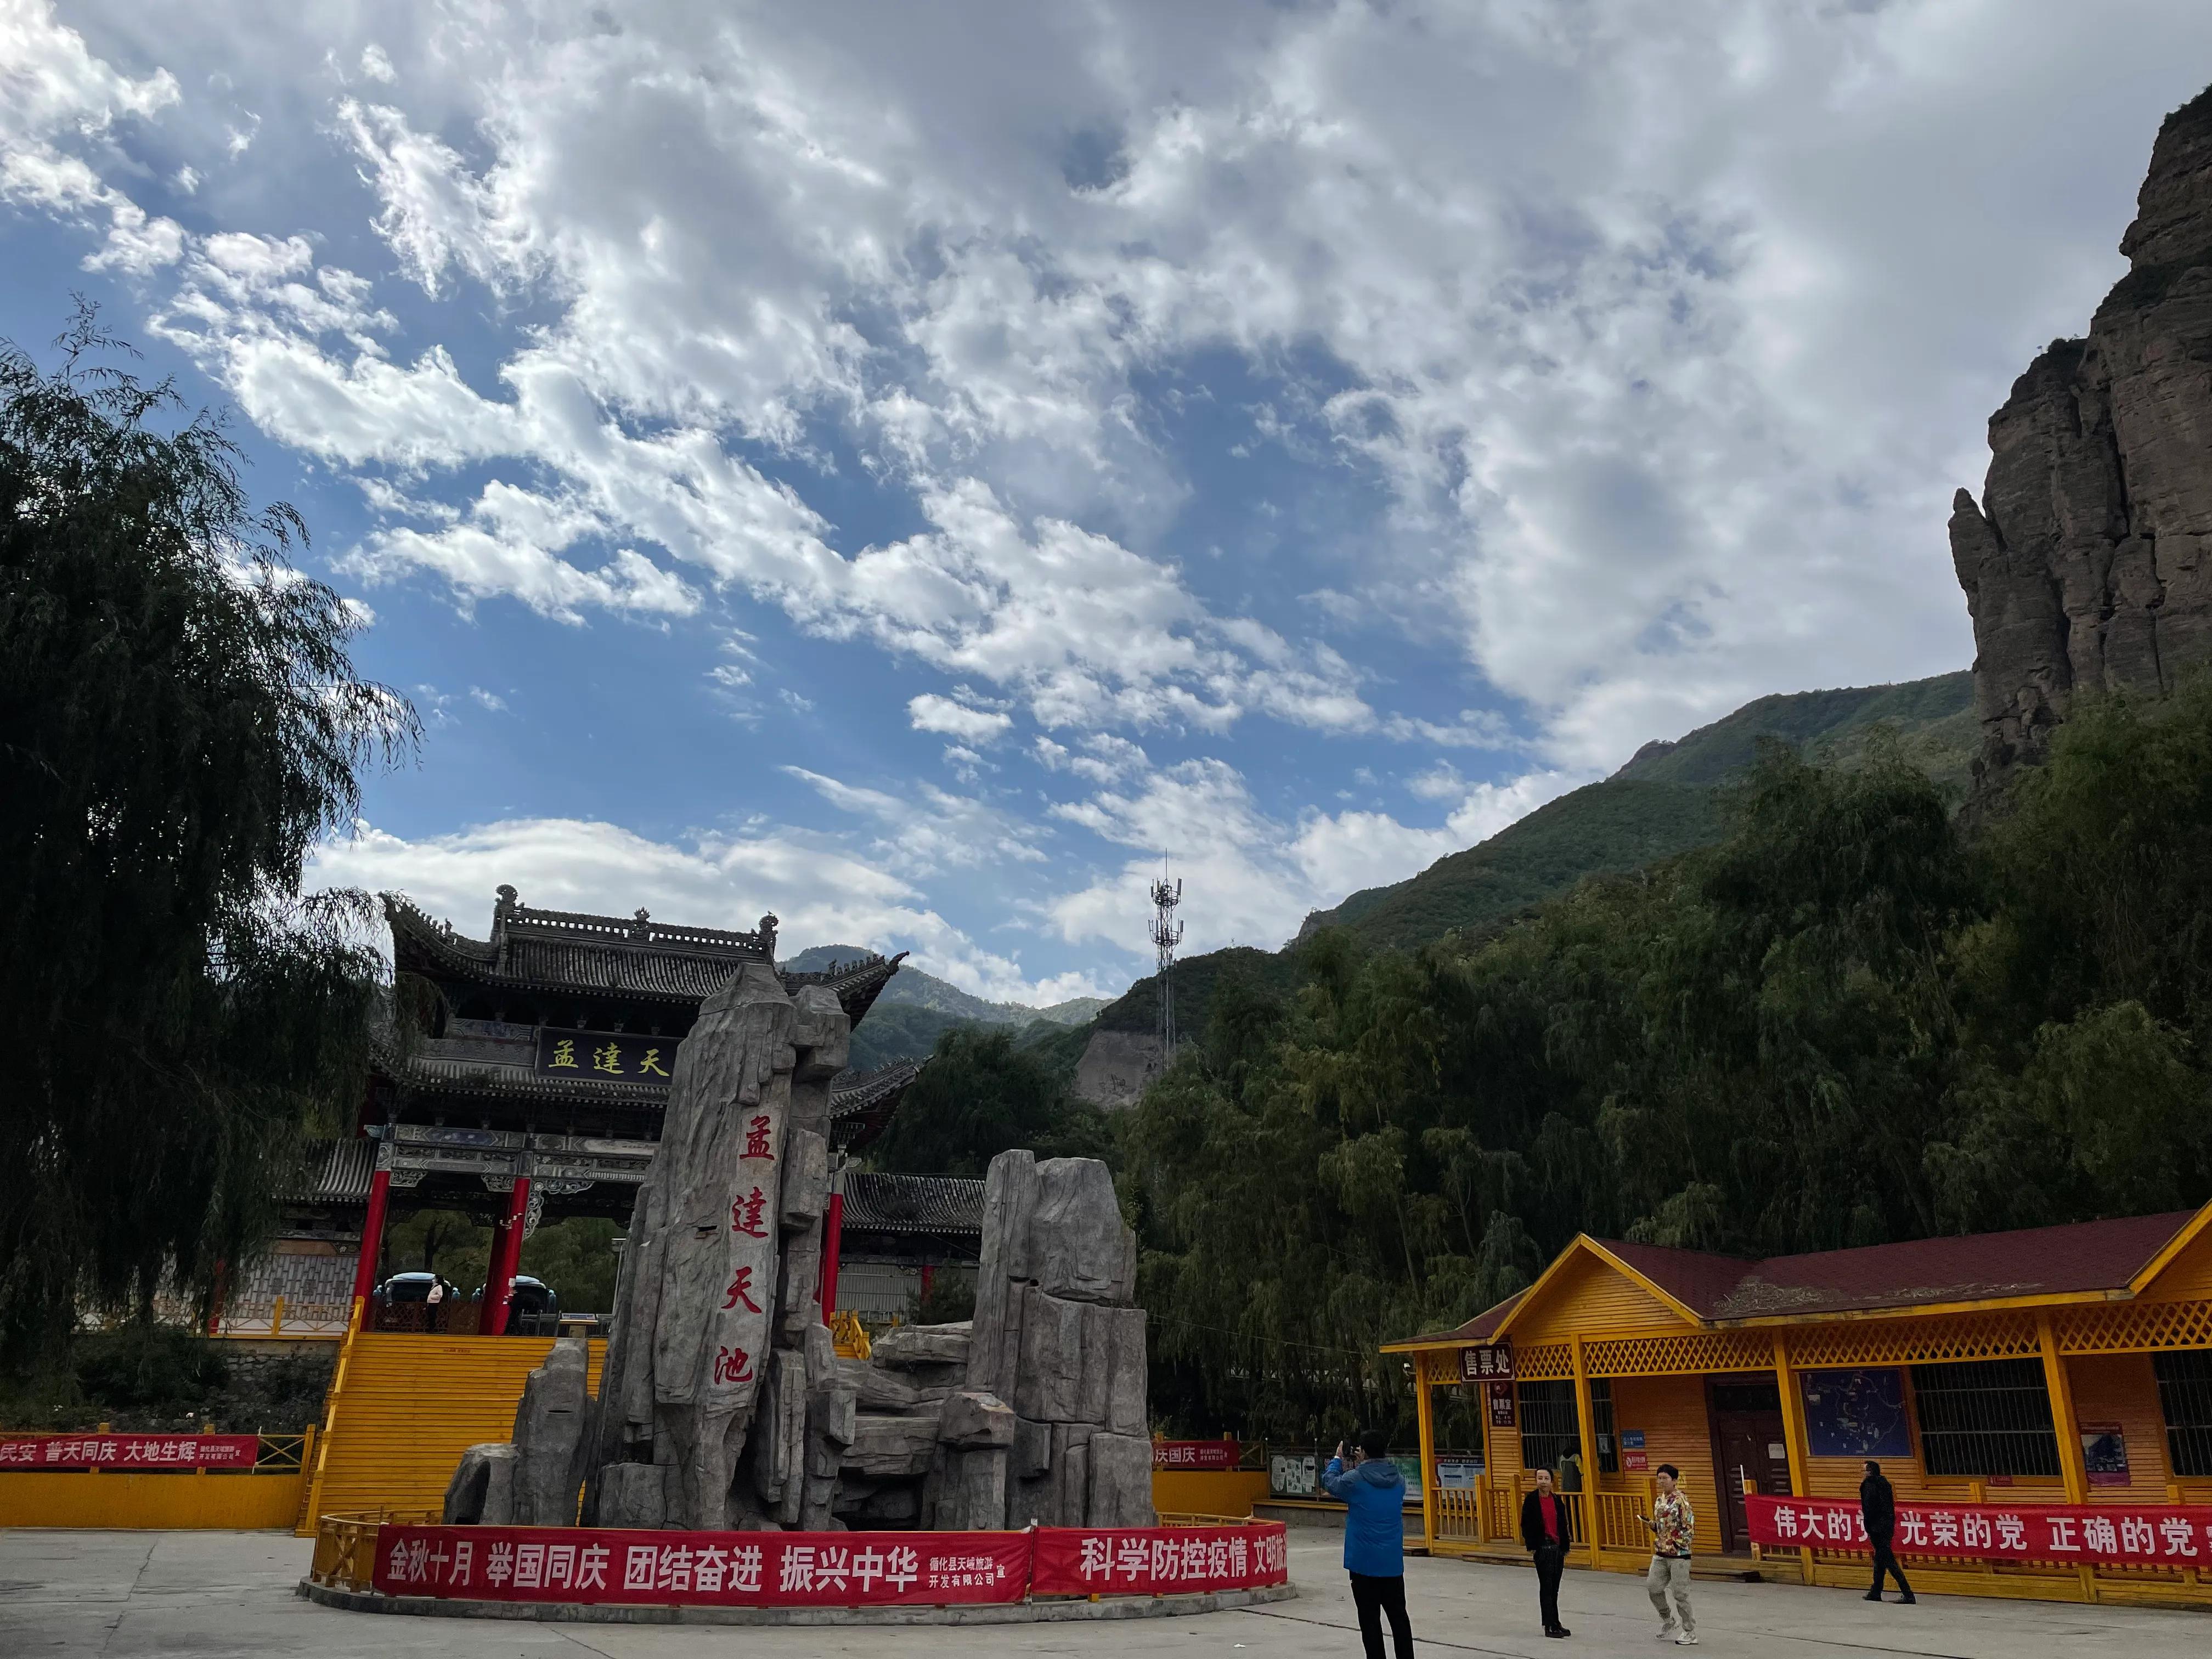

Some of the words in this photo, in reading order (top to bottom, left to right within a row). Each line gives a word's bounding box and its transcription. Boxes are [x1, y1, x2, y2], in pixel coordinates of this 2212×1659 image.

[714, 1115, 775, 1385] 孟達天池
[1465, 1349, 1510, 1376] 售票处
[0, 1443, 37, 1462] 民安
[46, 1441, 117, 1462] 普天同庆
[124, 1441, 197, 1462] 大地生辉
[1152, 1446, 1195, 1463] 庆国庆
[1900, 1511, 2028, 1550] 光荣的党
[2046, 1516, 2198, 1556] 正确的党
[387, 1538, 473, 1586] 金秋十月
[486, 1542, 610, 1590] 举国同庆
[624, 1544, 762, 1593] 团结奋进
[780, 1545, 917, 1593] 振兴中华
[930, 1556, 993, 1571] 循化县天域旅游
[1081, 1537, 1247, 1583] 科学防控疫情
[1254, 1533, 1286, 1575] 文明旅
[929, 1573, 994, 1588] 开发有限公司
[996, 1564, 1006, 1578] 宣
